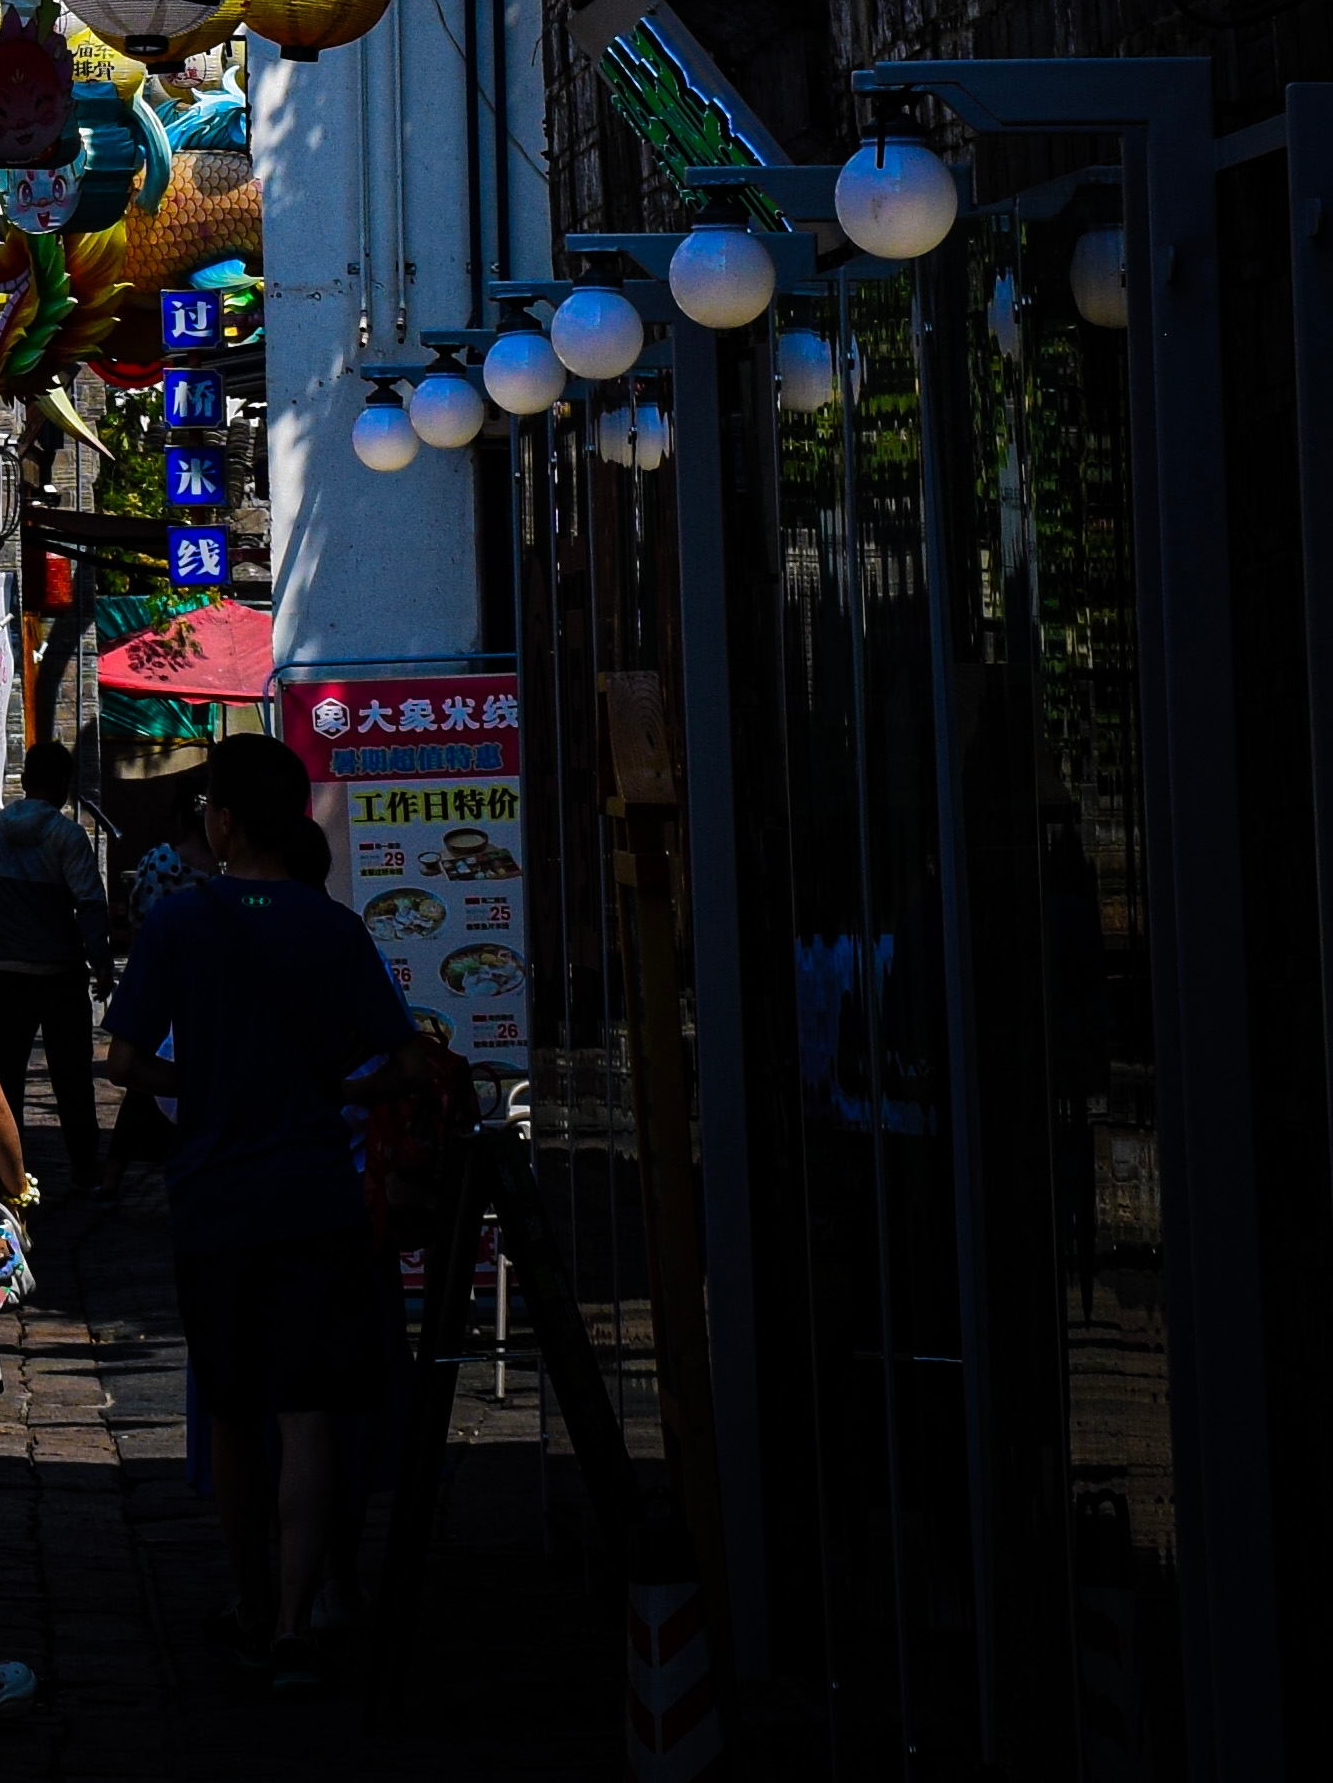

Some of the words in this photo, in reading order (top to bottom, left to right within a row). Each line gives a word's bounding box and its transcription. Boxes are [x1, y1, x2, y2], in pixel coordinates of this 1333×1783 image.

[74, 44, 115, 59] 庙东
[73, 60, 115, 80] 排骨
[170, 300, 221, 579] 过桥米线
[358, 694, 519, 734] 大象米线
[331, 742, 504, 776] 暑期超值特惠
[353, 787, 519, 823] 工作日特价
